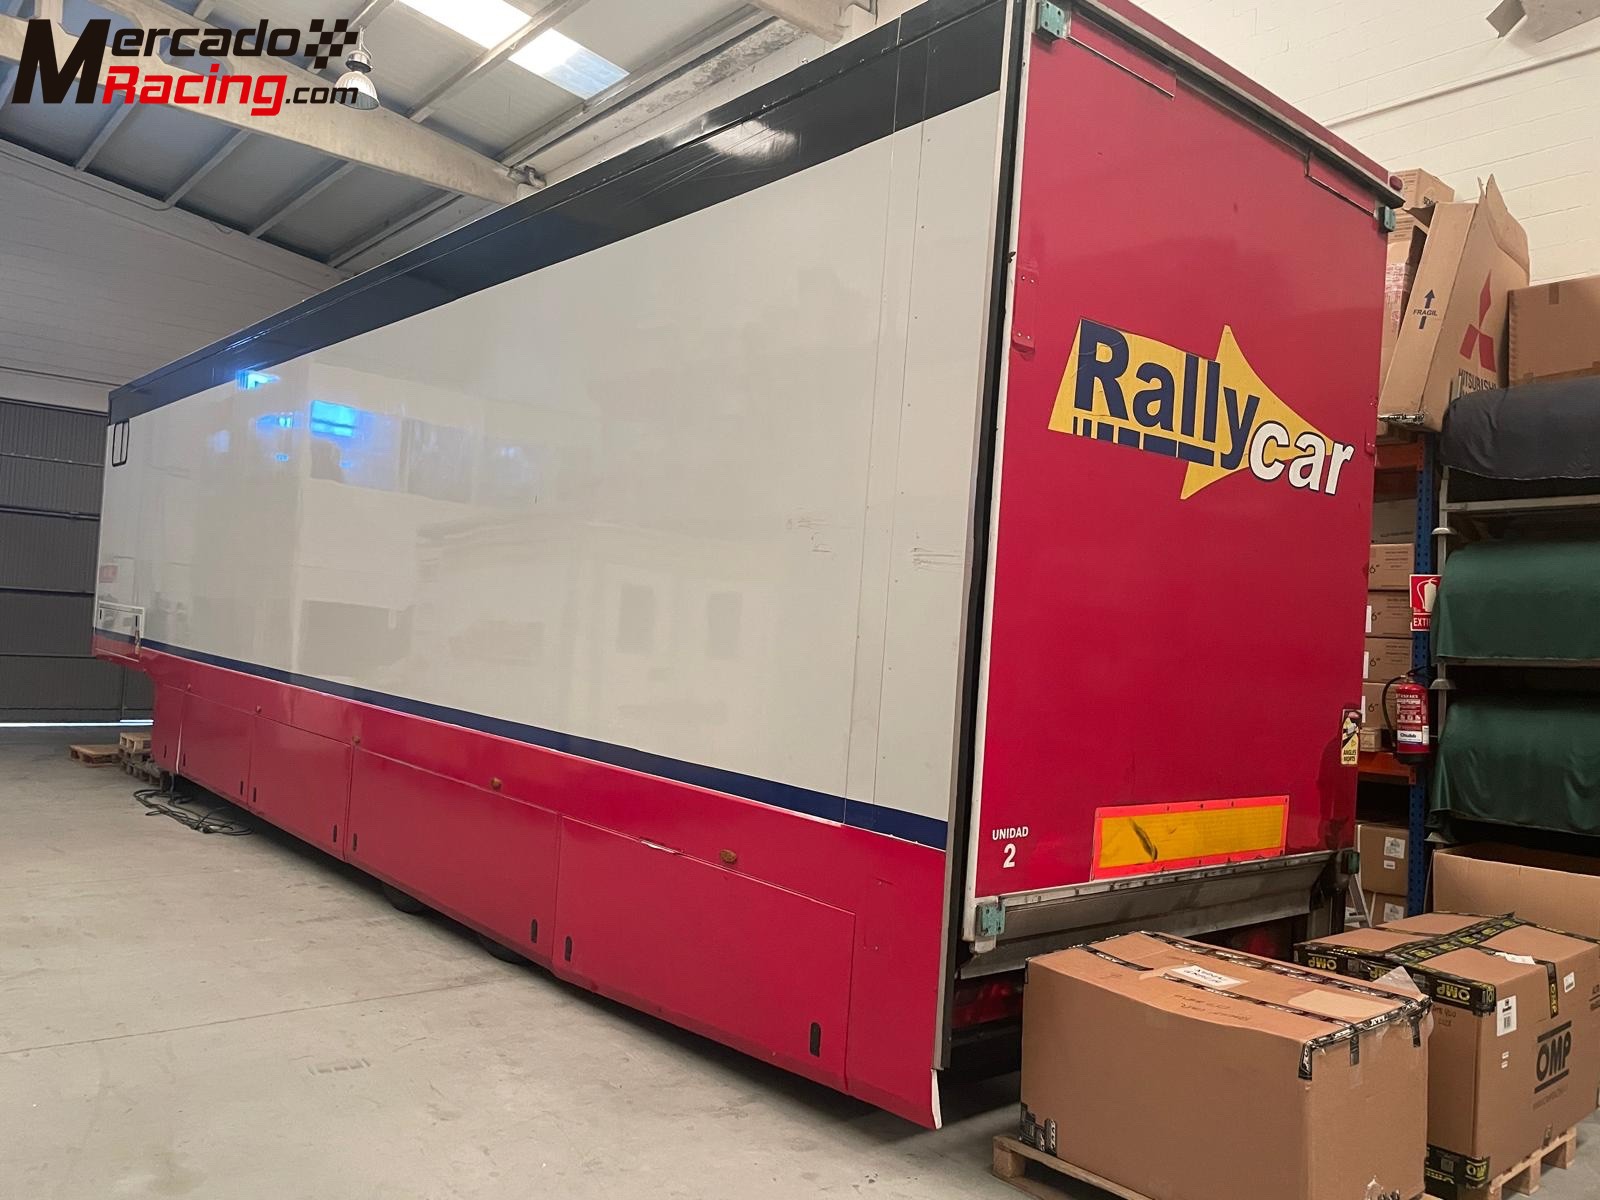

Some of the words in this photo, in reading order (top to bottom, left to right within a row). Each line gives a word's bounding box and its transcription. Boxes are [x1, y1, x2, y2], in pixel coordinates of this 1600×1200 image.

[1413, 308, 1438, 317] FRAGIL
[1413, 617, 1431, 627] EXTI
[992, 826, 1029, 841] UNIDAD
[1003, 843, 1016, 868] 2
[1436, 982, 1470, 1001] OMP
[1536, 1031, 1572, 1082] OMP
